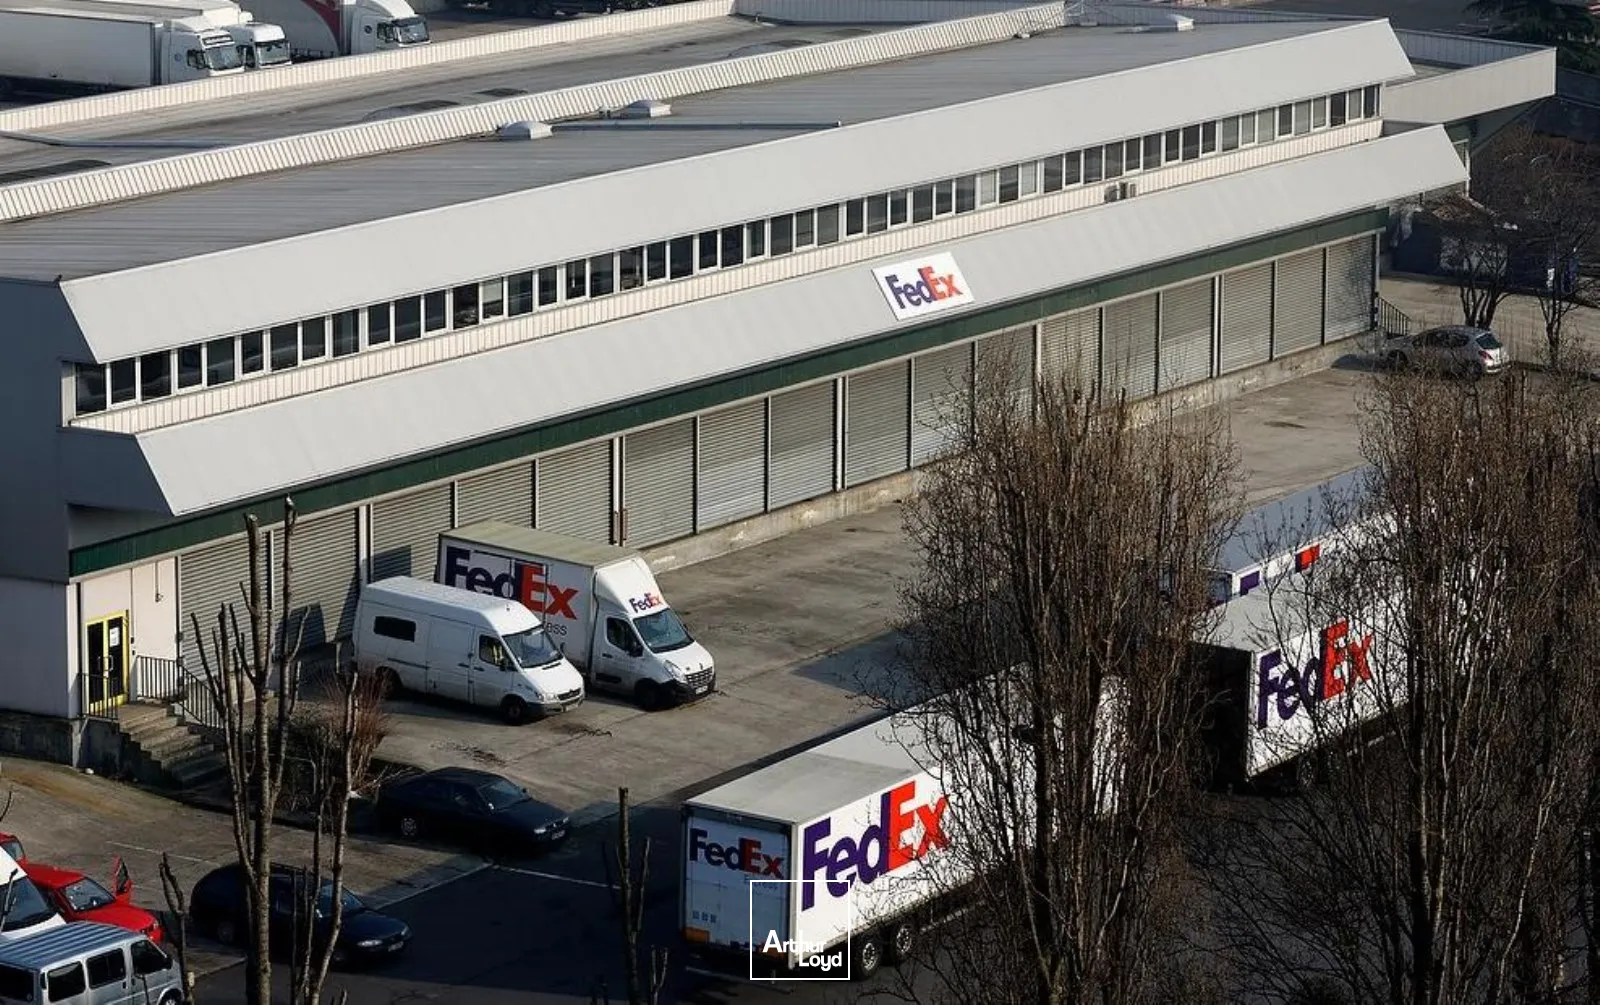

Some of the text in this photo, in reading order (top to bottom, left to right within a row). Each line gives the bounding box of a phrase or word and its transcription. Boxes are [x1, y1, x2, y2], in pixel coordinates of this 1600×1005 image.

[885, 266, 963, 309] FedEx
[446, 546, 579, 620] FedEx
[629, 592, 663, 613] FedEx
[1257, 619, 1374, 730] FedEx
[689, 827, 785, 879] FedEx
[801, 780, 951, 912] FedEx
